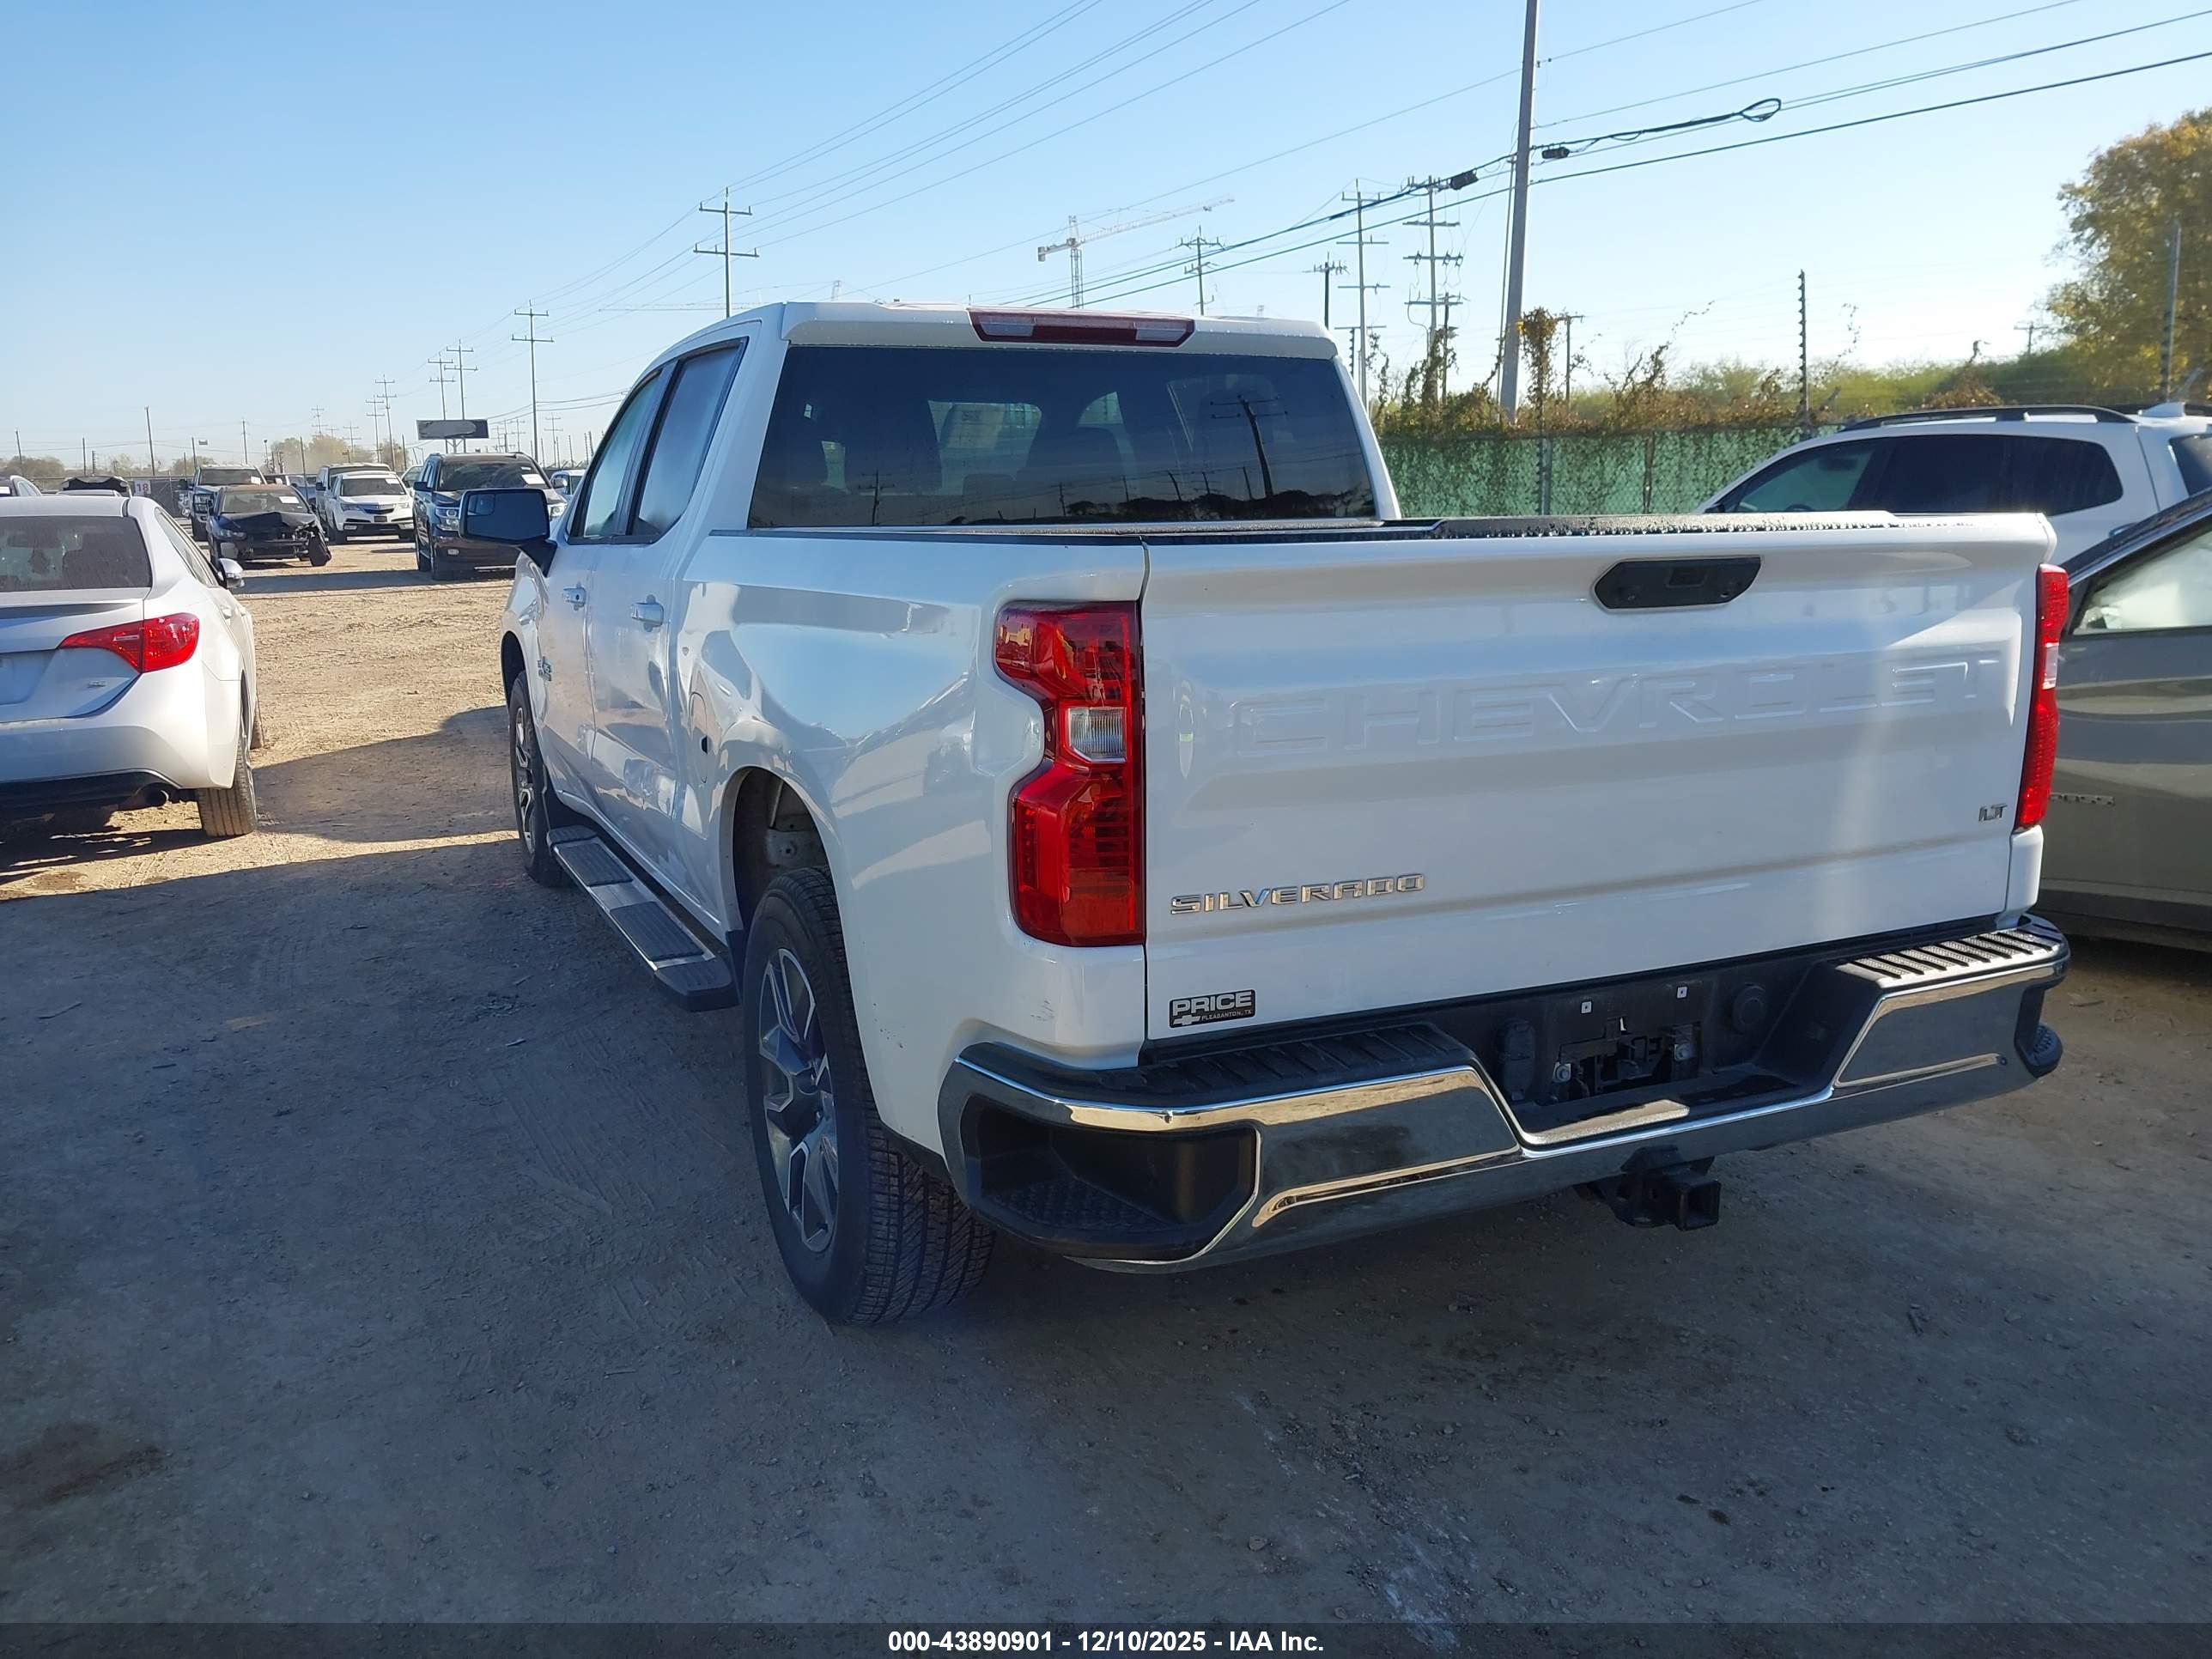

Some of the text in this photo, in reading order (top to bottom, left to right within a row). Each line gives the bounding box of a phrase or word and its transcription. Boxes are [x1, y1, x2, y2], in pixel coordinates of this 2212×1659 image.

[1229, 650, 2002, 757] CHEVROLET
[1170, 872, 1425, 915] SILVERADO
[1172, 991, 1252, 1017] PRICE
